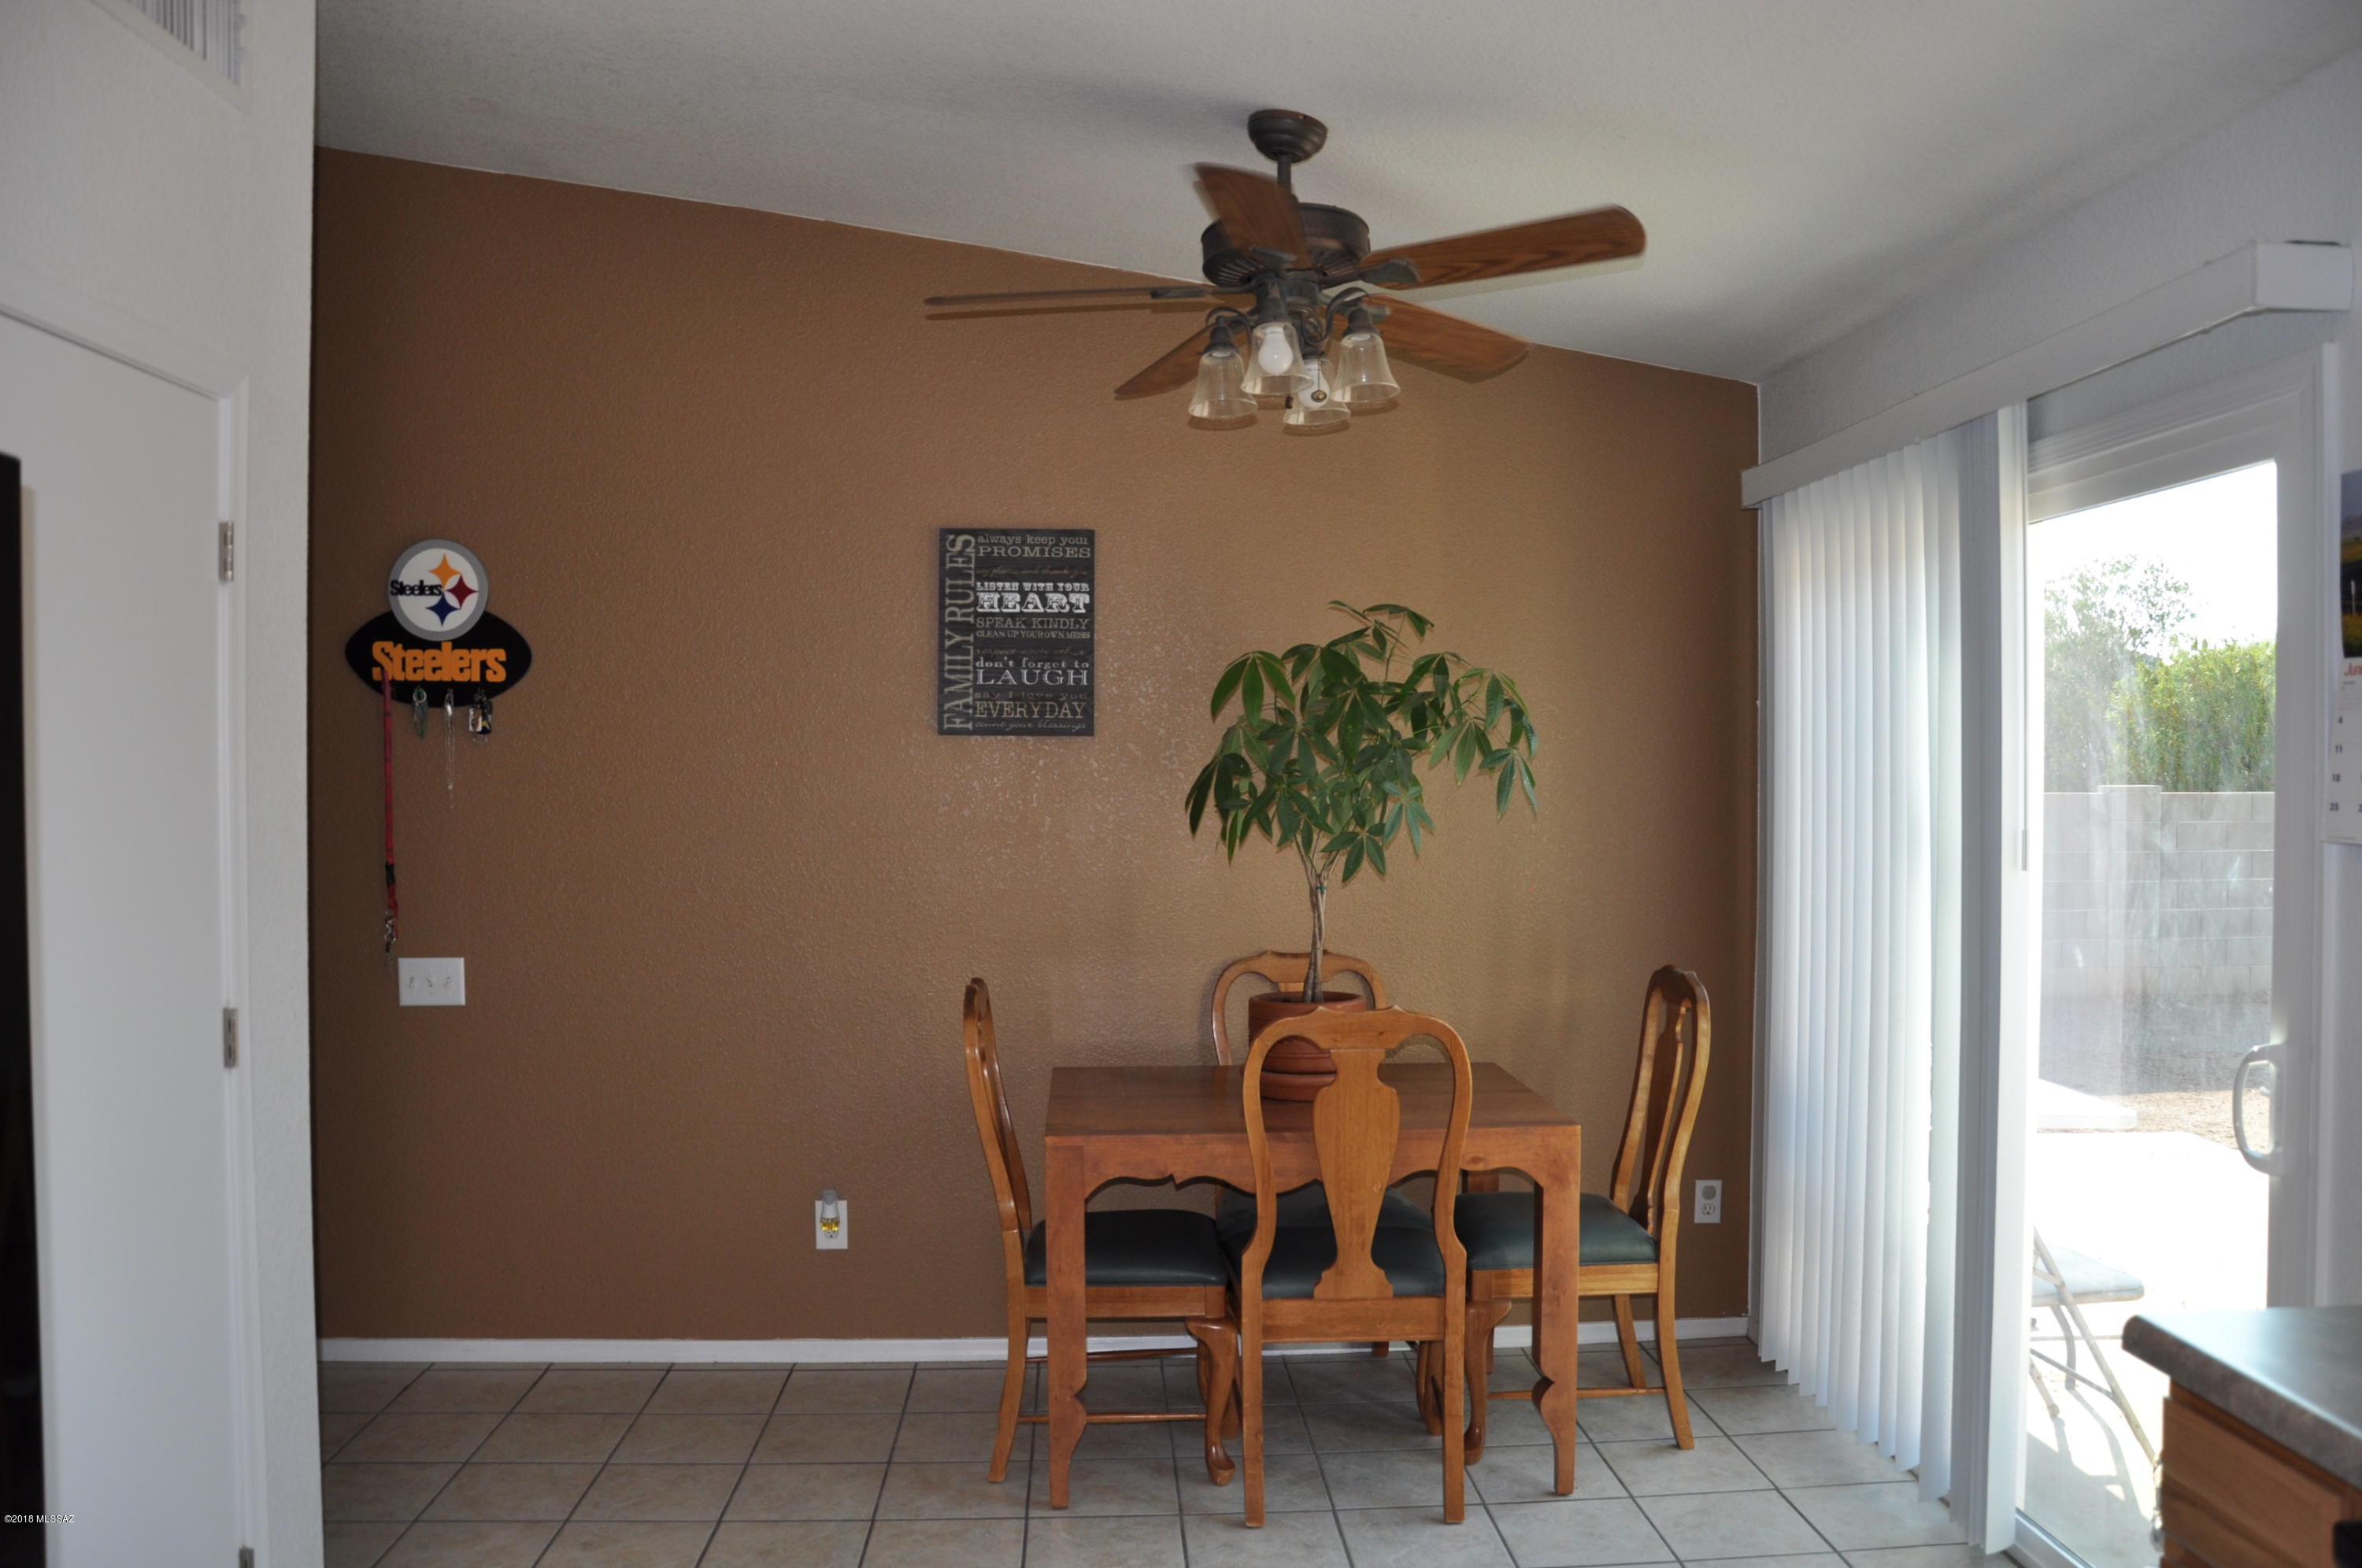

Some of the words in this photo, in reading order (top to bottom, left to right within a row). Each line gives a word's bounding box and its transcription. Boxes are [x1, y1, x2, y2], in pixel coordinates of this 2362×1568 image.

[977, 534, 1021, 545] always
[1027, 534, 1056, 545] keep
[1060, 537, 1088, 545] your
[977, 546, 1091, 558] PROMISES
[1041, 565, 1068, 575] thank
[946, 534, 976, 623] RULES
[391, 580, 442, 596] Steelers
[976, 582, 1019, 590] LISTEN
[1022, 582, 1053, 591] WITH
[1057, 582, 1090, 591] YOUR
[976, 592, 1090, 613] HEART
[976, 617, 1026, 628] SPEAK
[1031, 618, 1090, 630] KINDLY
[372, 641, 506, 682] Steelers
[976, 656, 1014, 668] don't
[1022, 657, 1065, 669] forget
[944, 629, 975, 730] FAMILY
[976, 669, 1089, 686] LAUGH
[1038, 719, 1086, 731] blessings
